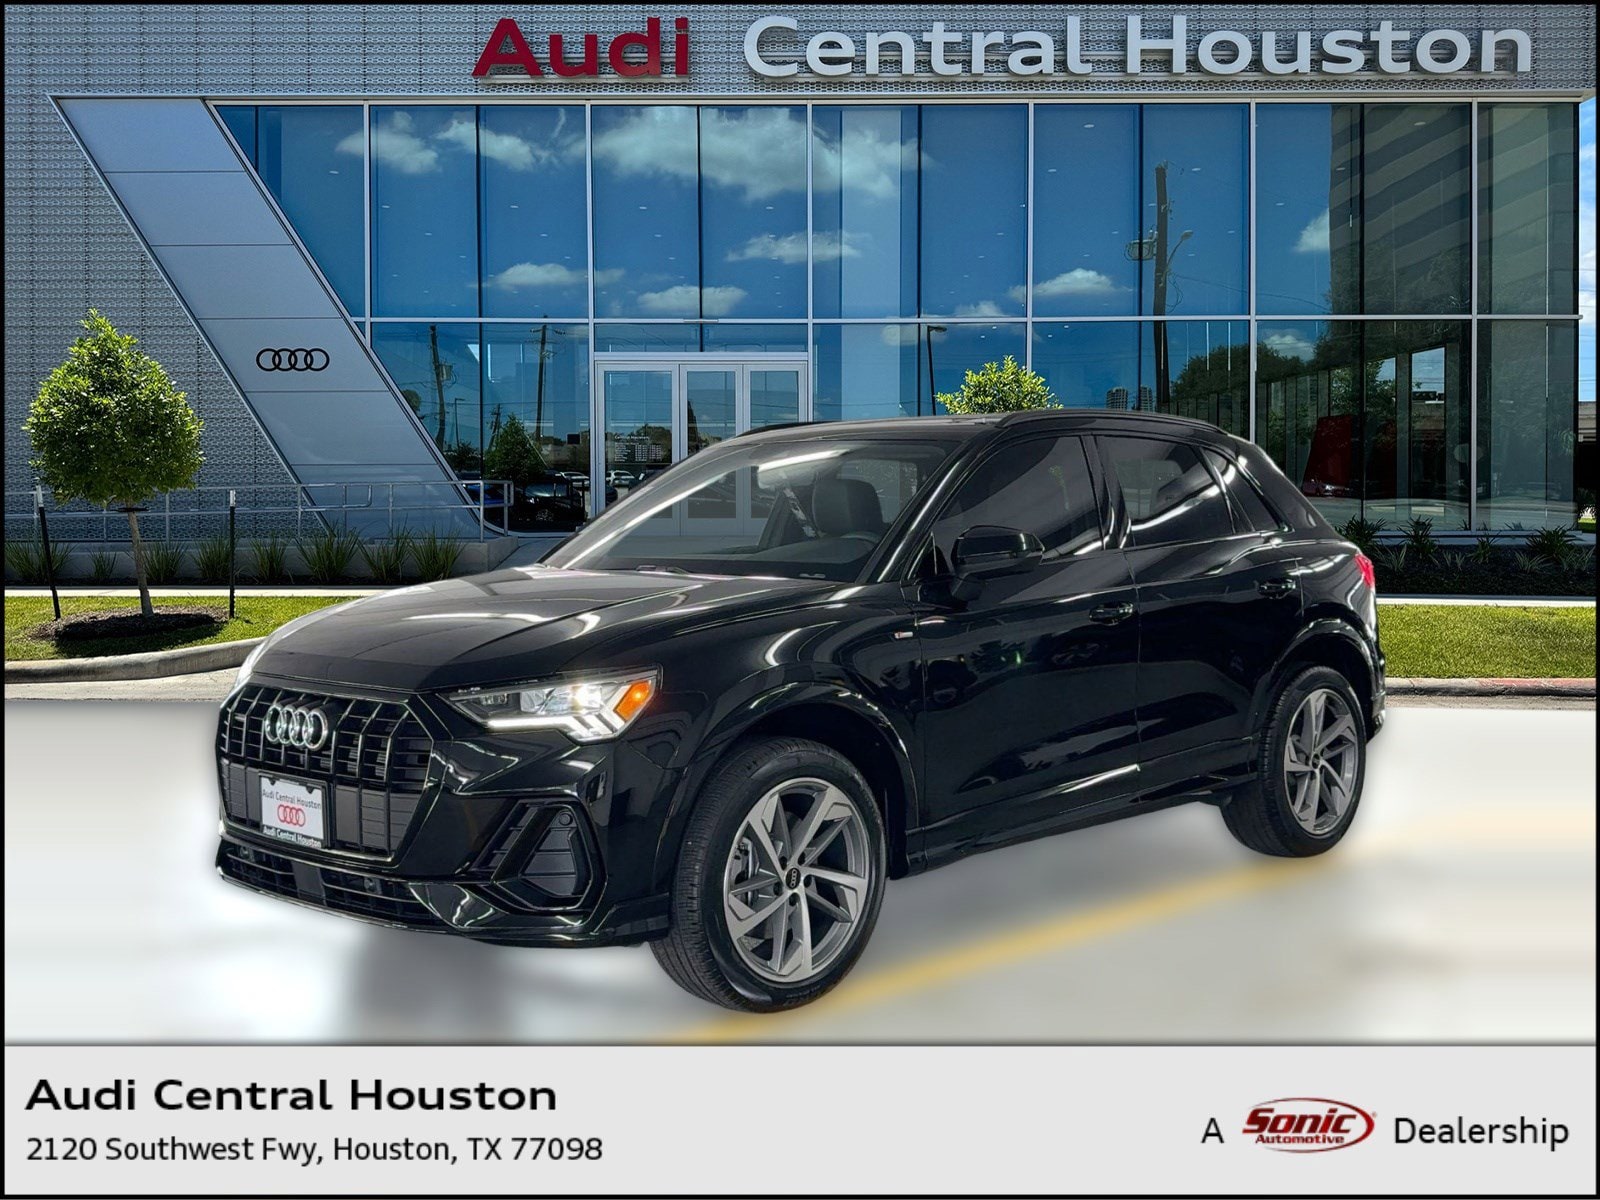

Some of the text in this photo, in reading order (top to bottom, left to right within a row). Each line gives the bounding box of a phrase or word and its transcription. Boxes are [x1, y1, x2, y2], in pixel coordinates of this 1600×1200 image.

[471, 15, 1532, 78] Audi Central Houston
[262, 789, 321, 809] Audi Central Houston
